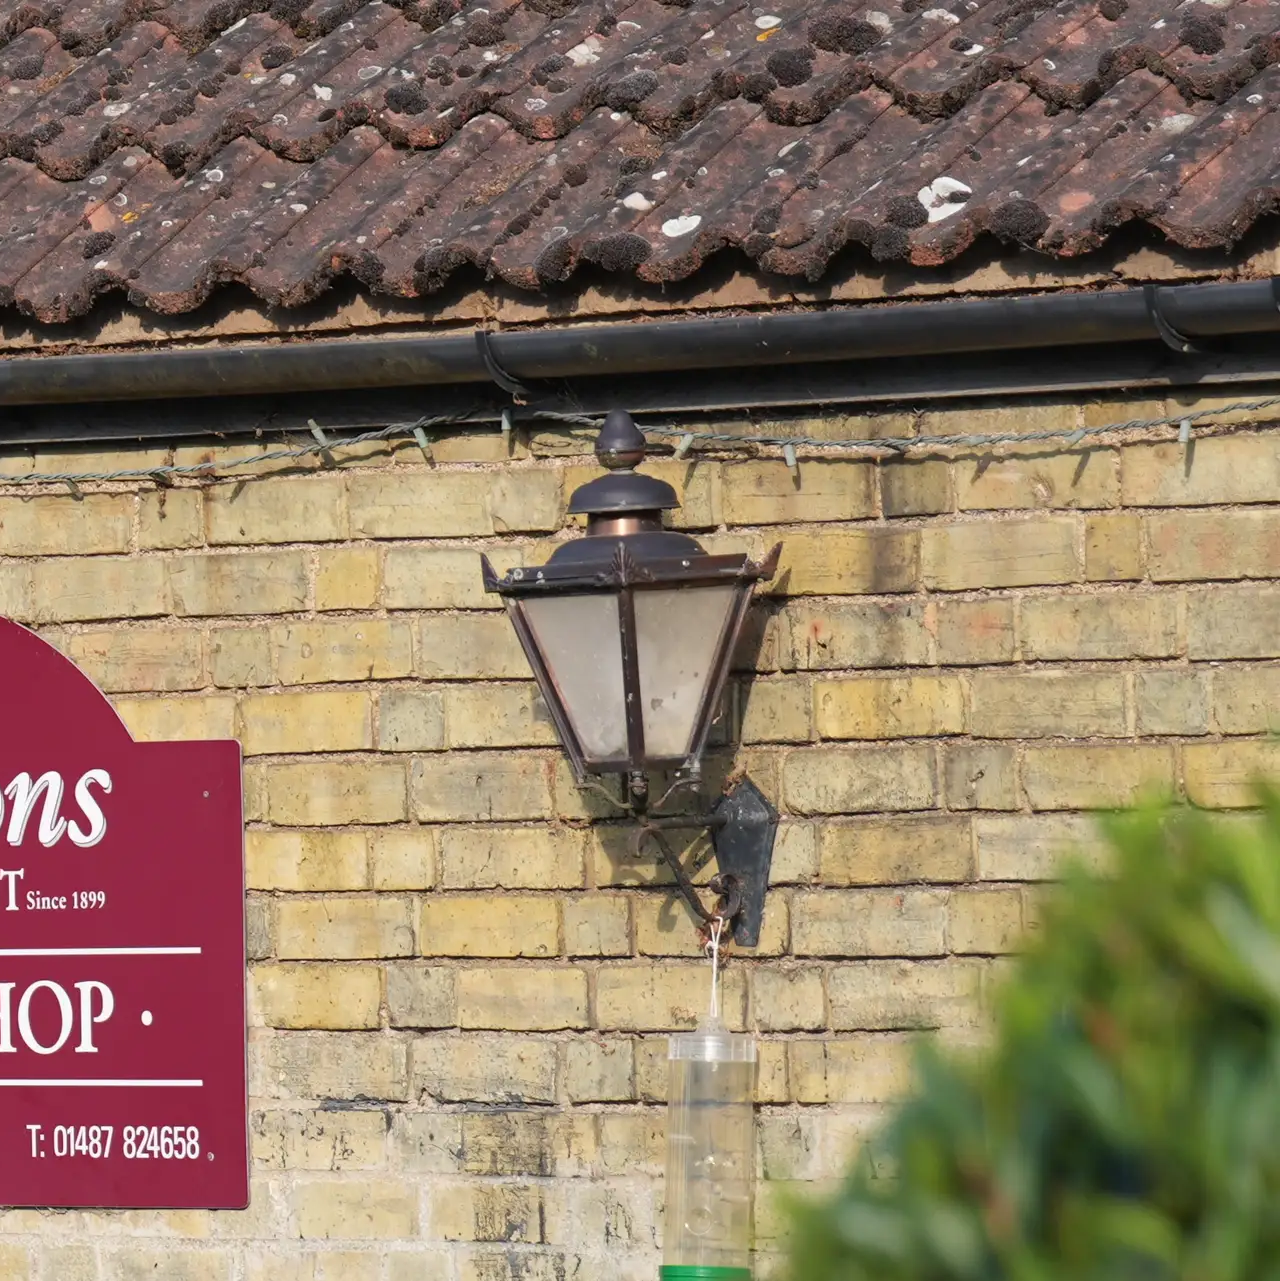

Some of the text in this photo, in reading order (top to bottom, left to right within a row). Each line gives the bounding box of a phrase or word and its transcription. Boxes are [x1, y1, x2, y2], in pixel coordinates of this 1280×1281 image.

[26, 890, 68, 911] Since
[70, 890, 107, 911] 1899
[25, 1124, 46, 1159] T:
[53, 1124, 114, 1159] 01487
[122, 1125, 200, 1160] 824658
